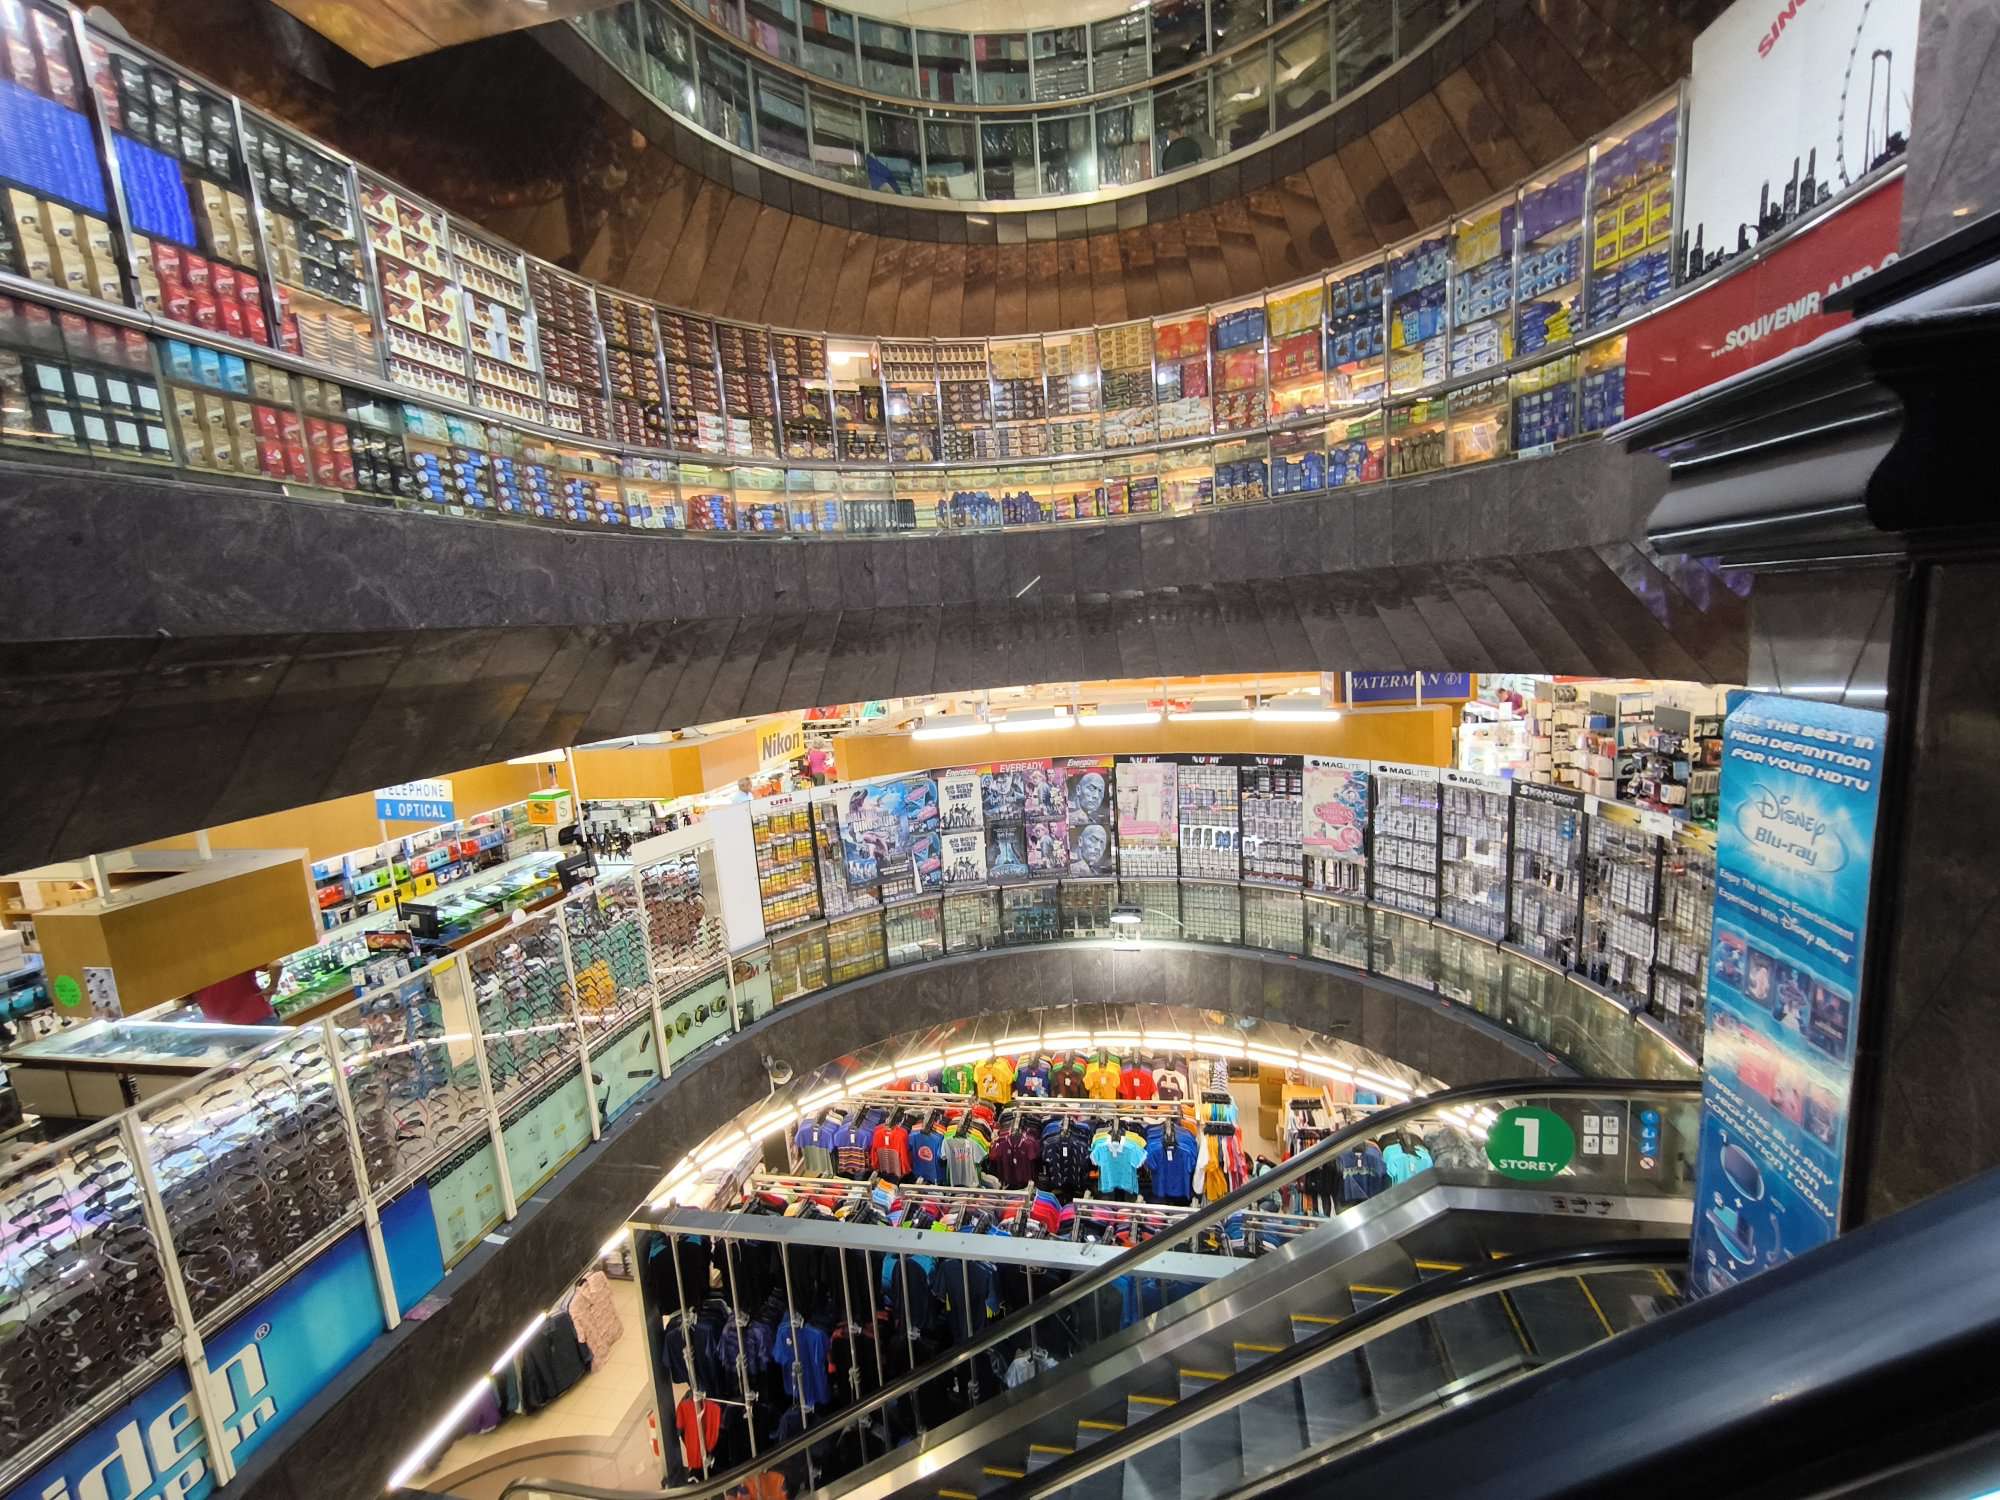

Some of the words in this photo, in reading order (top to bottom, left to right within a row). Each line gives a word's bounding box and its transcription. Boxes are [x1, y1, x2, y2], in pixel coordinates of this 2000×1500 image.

[1730, 730, 1768, 746] HIGH
[1766, 719, 1799, 734] THE
[1801, 725, 1850, 744] BEST
[762, 731, 800, 760] Nikon
[1321, 761, 1361, 770] MAGLITE
[1730, 748, 1765, 763] FOR
[1767, 755, 1814, 776] YOUR
[1389, 766, 1433, 778] MAGLITE
[1459, 775, 1502, 790] MAGLITE
[398, 803, 447, 818] OPTICAL
[1754, 826, 1818, 866] Blu-ray
[1514, 1117, 1540, 1157] 1
[1499, 1159, 1558, 1172] STOREY
